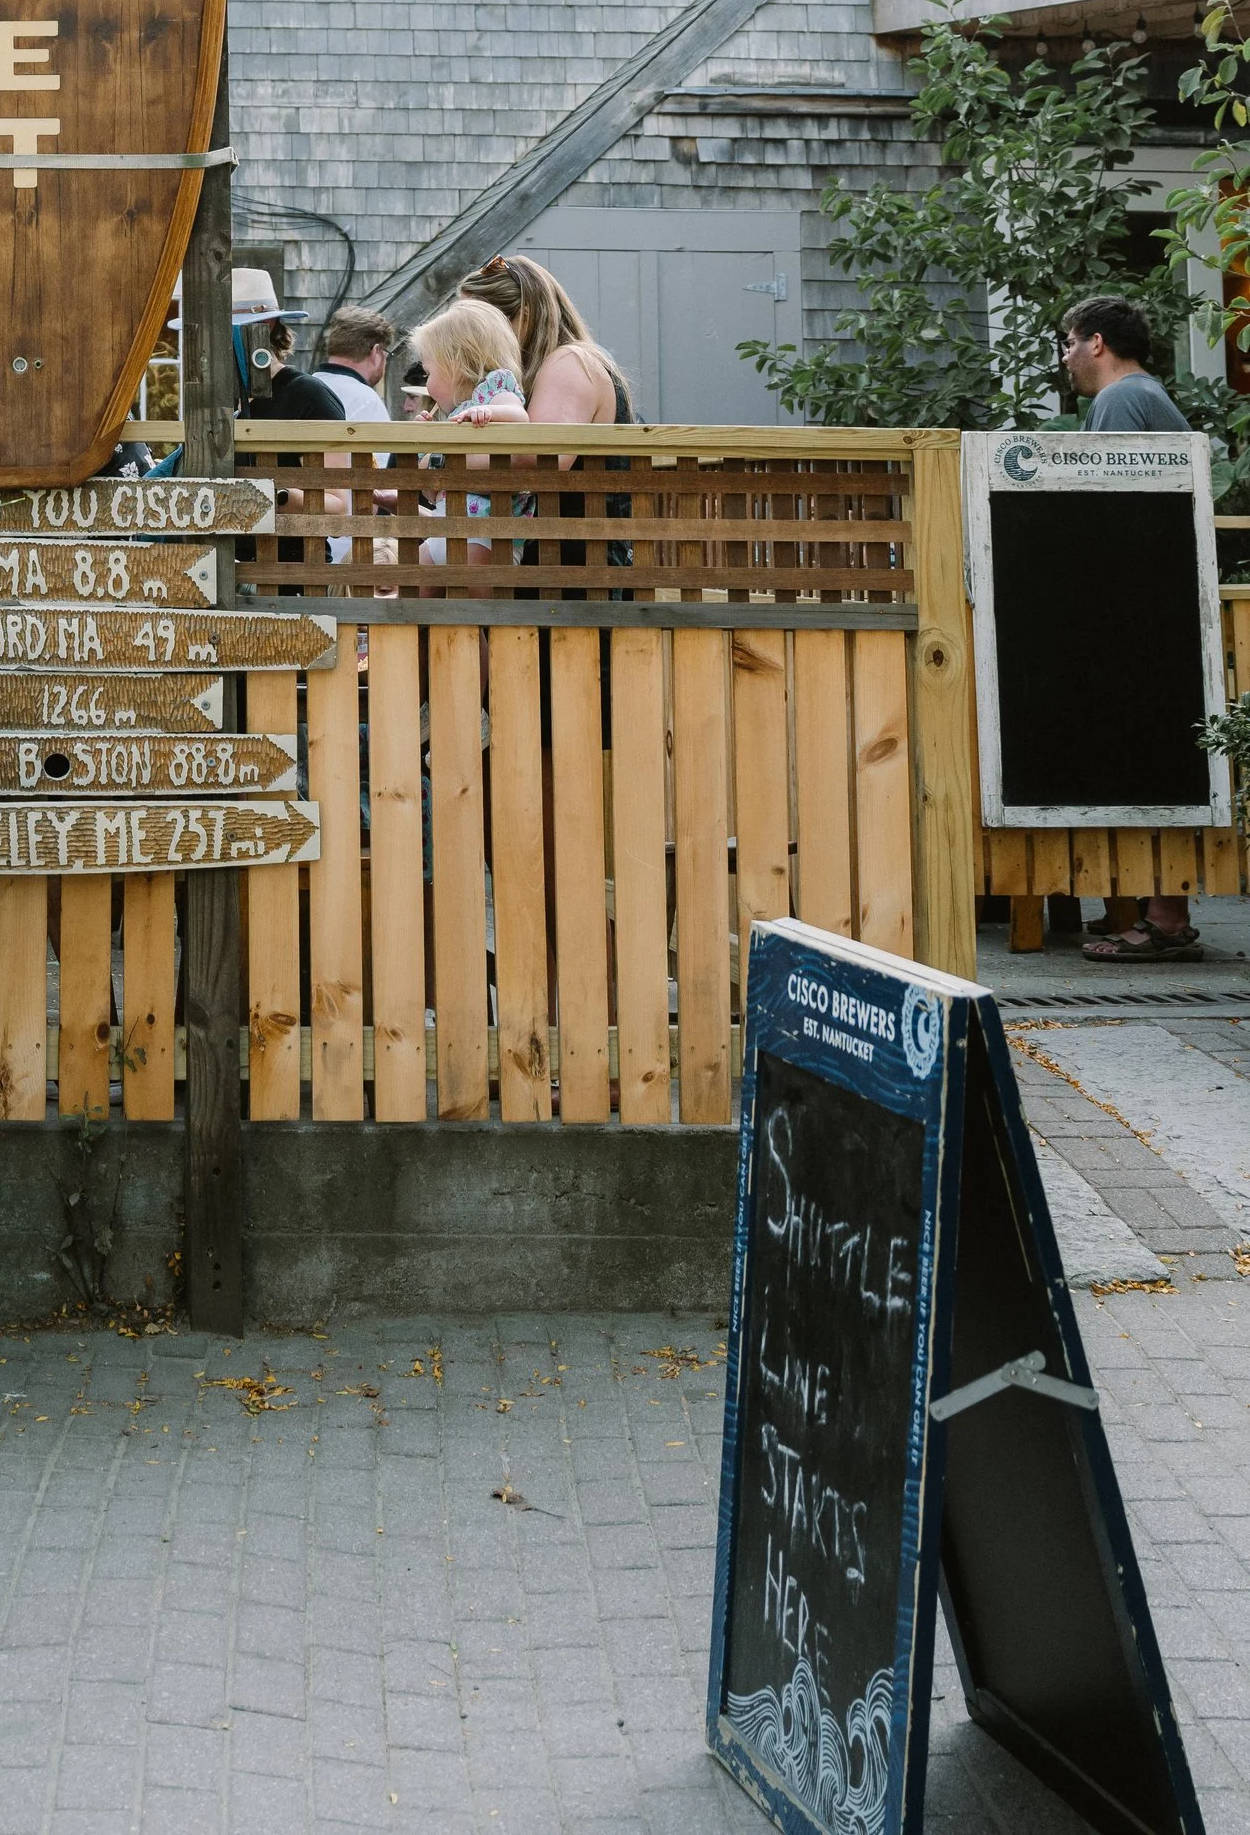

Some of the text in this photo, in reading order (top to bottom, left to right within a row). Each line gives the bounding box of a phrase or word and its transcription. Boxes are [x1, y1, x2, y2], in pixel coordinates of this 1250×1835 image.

[993, 435, 1048, 464] CISCO BREWERS
[1051, 452, 1189, 465] CISCO BREWERS
[1077, 469, 1163, 477] EST. NANTUCKET
[23, 486, 98, 528] YOU
[111, 484, 216, 529] CISCO
[74, 548, 130, 599] 8.8
[58, 614, 103, 662] MA
[134, 618, 176, 664] 49
[42, 683, 107, 728] 1266
[169, 742, 234, 787] 88.8
[96, 810, 154, 865] ME
[165, 809, 226, 863] 257
[787, 973, 896, 1042] CISCO BREWERS
[803, 1016, 875, 1063] EST. NANTUCKET
[741, 1130, 749, 1159] GET
[739, 1162, 747, 1198] CAN
[737, 1201, 745, 1234] YOU
[922, 1209, 932, 1253] NICE
[734, 1258, 742, 1291] BEER
[920, 1256, 930, 1297] BEER
[732, 1294, 740, 1333] NICE
[916, 1323, 926, 1361] YOU
[914, 1365, 924, 1405] CAN
[911, 1409, 920, 1445] GET
[761, 1422, 867, 1584] STARTS
[763, 1533, 831, 1703] HERE
